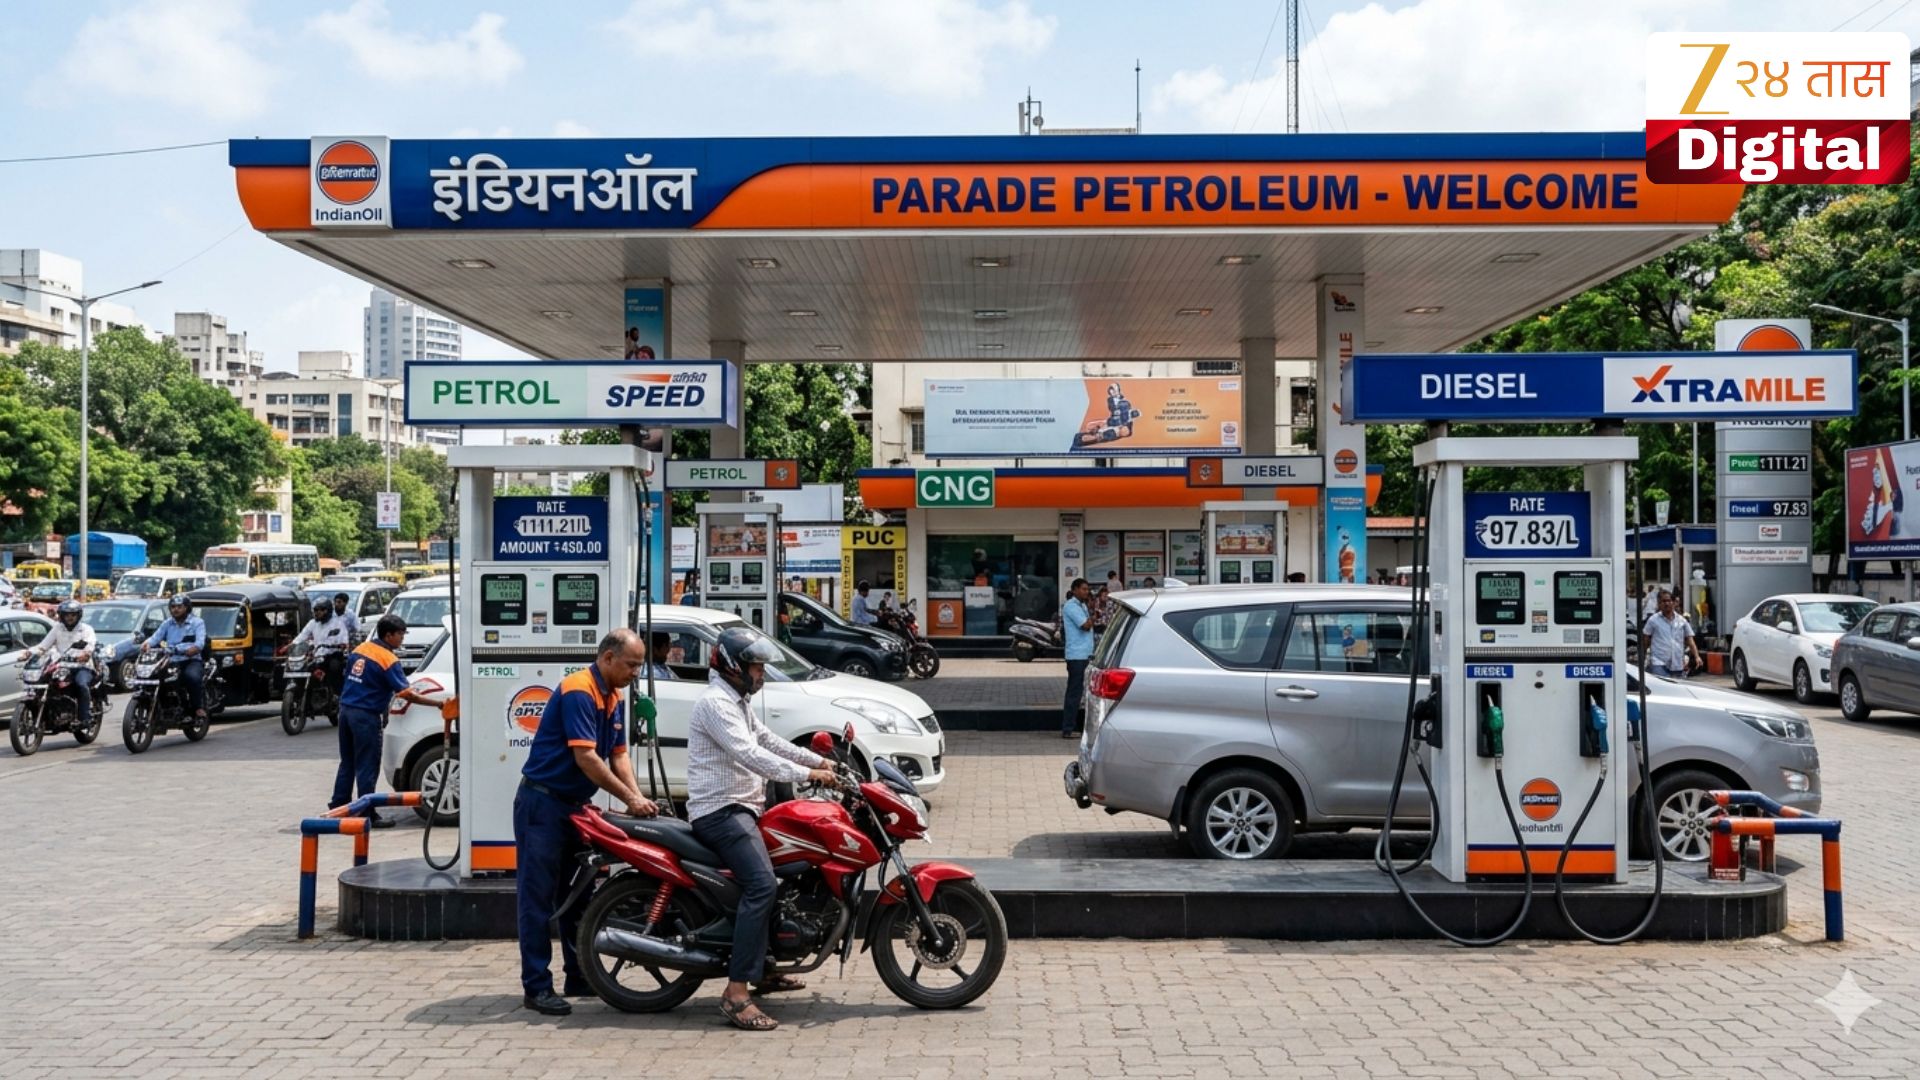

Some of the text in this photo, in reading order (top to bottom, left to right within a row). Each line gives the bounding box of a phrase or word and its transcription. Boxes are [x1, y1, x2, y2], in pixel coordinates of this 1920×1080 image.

[430, 153, 698, 222] इंडियनऑल
[872, 176, 1056, 214] PARADE
[1073, 174, 1359, 213] PETROLEUM
[1404, 172, 1638, 210] WELCOME
[433, 380, 560, 405] PETROL
[1420, 373, 1538, 400] DIESEL
[1631, 364, 1826, 403] XTRAMILE
[605, 385, 705, 408] SPEED
[689, 467, 748, 480] PETROL
[1244, 465, 1297, 478] DIESEL
[920, 475, 990, 502] CNG
[1509, 497, 1546, 512] RATE
[499, 541, 550, 554] AMOUNT
[852, 530, 895, 546] PUC
